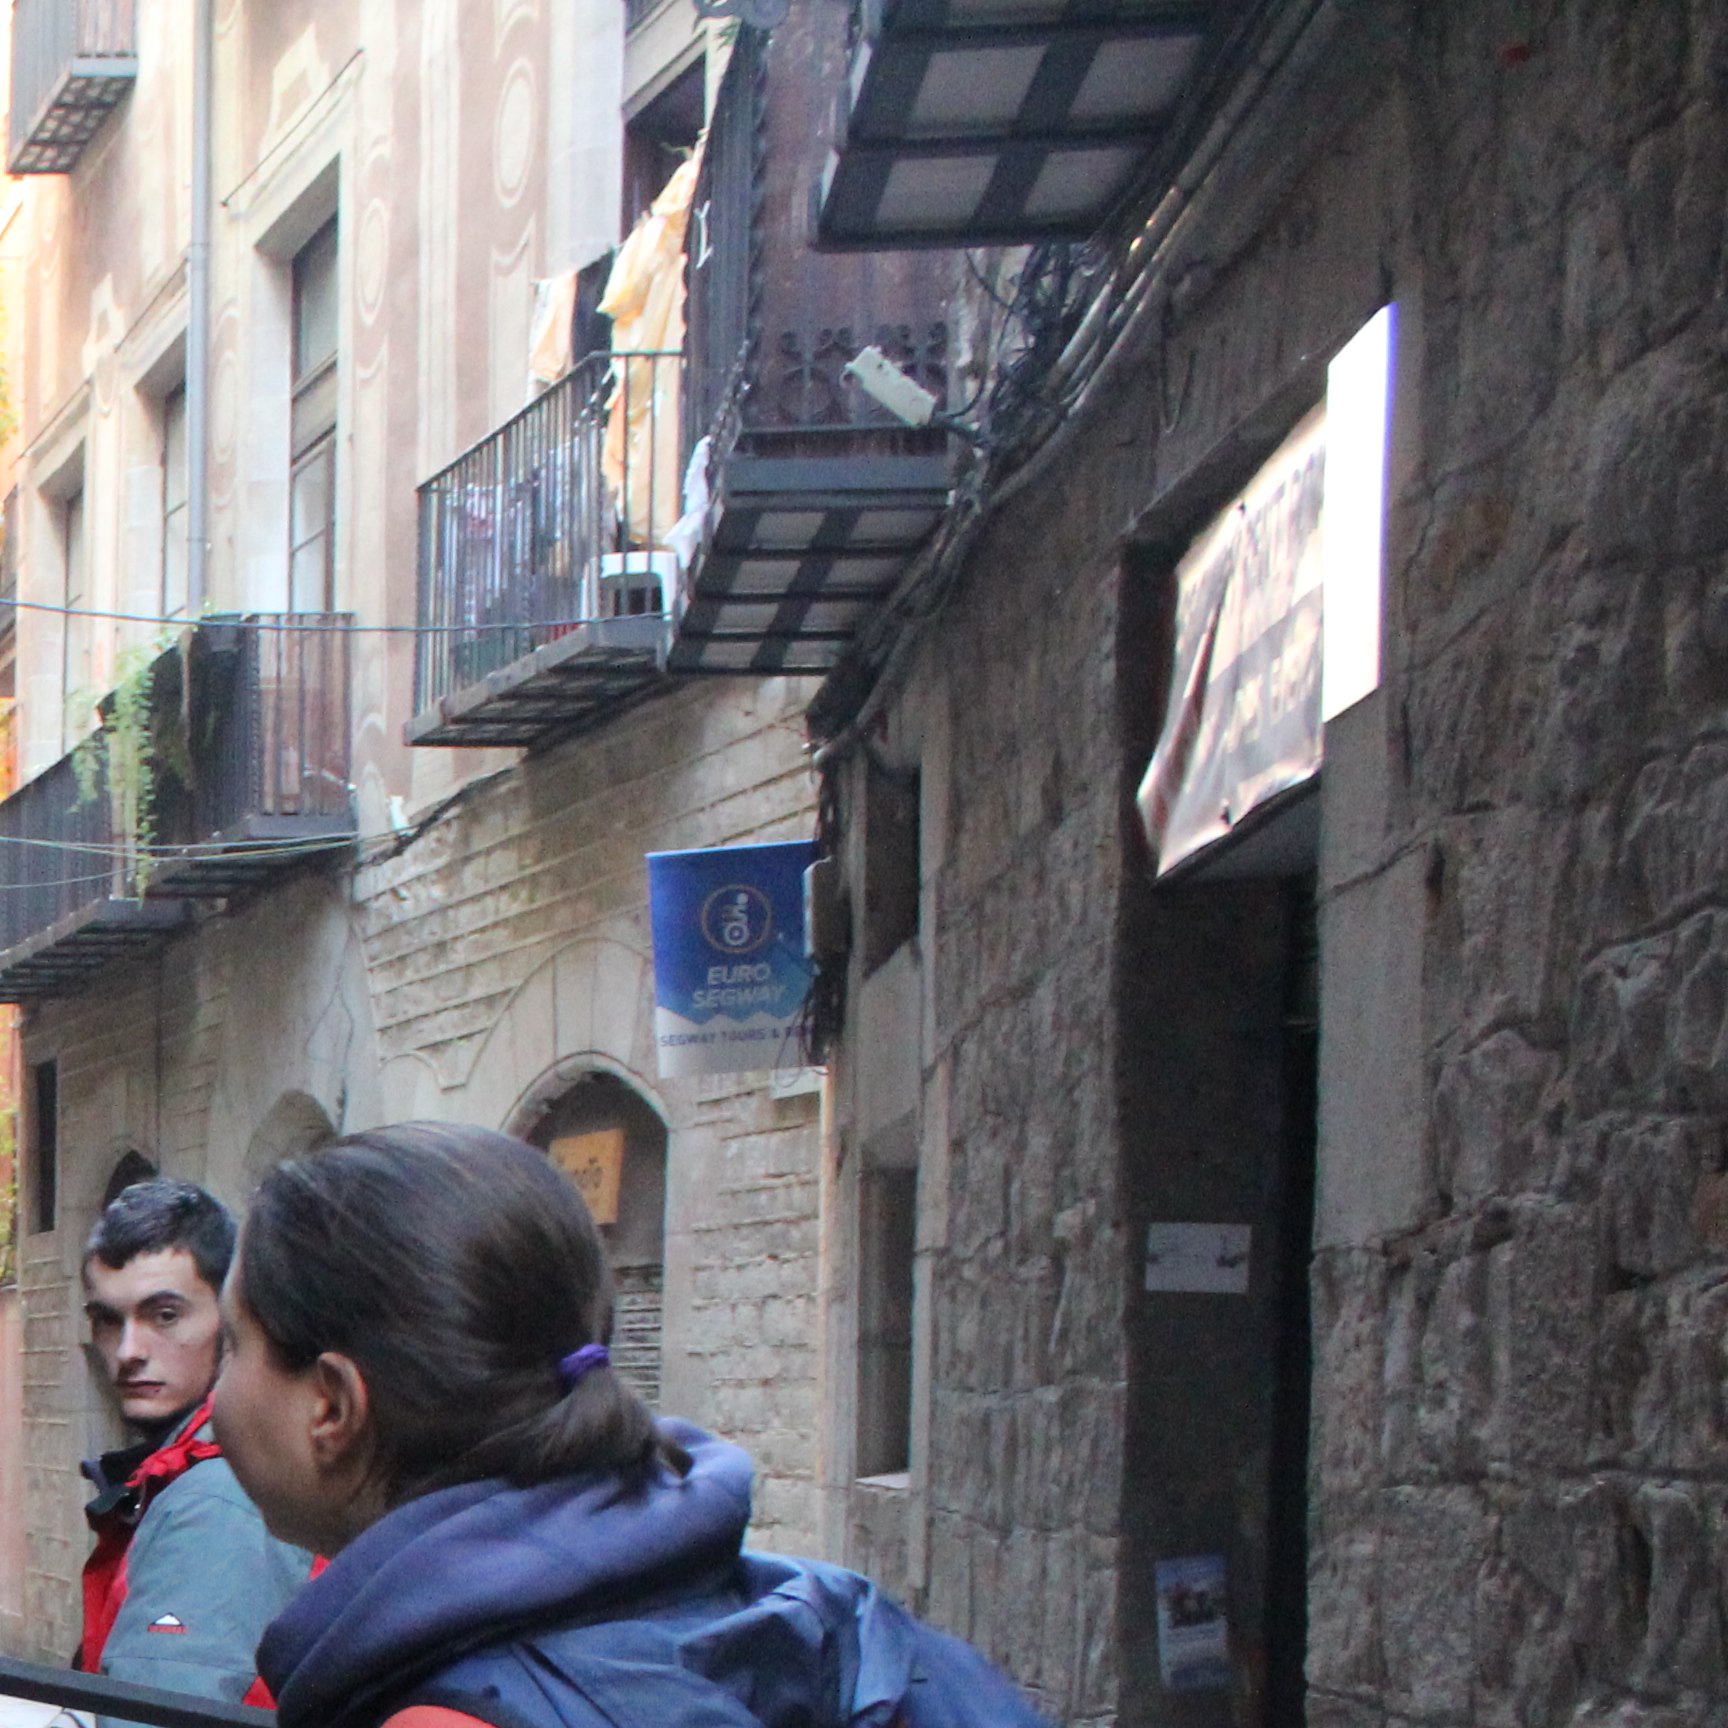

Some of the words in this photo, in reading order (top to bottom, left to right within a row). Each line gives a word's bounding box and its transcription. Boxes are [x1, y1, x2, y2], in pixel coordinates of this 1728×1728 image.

[707, 962, 771, 985] EURO
[692, 984, 786, 1009] SEGWAY
[660, 1033, 716, 1047] SEGWAY
